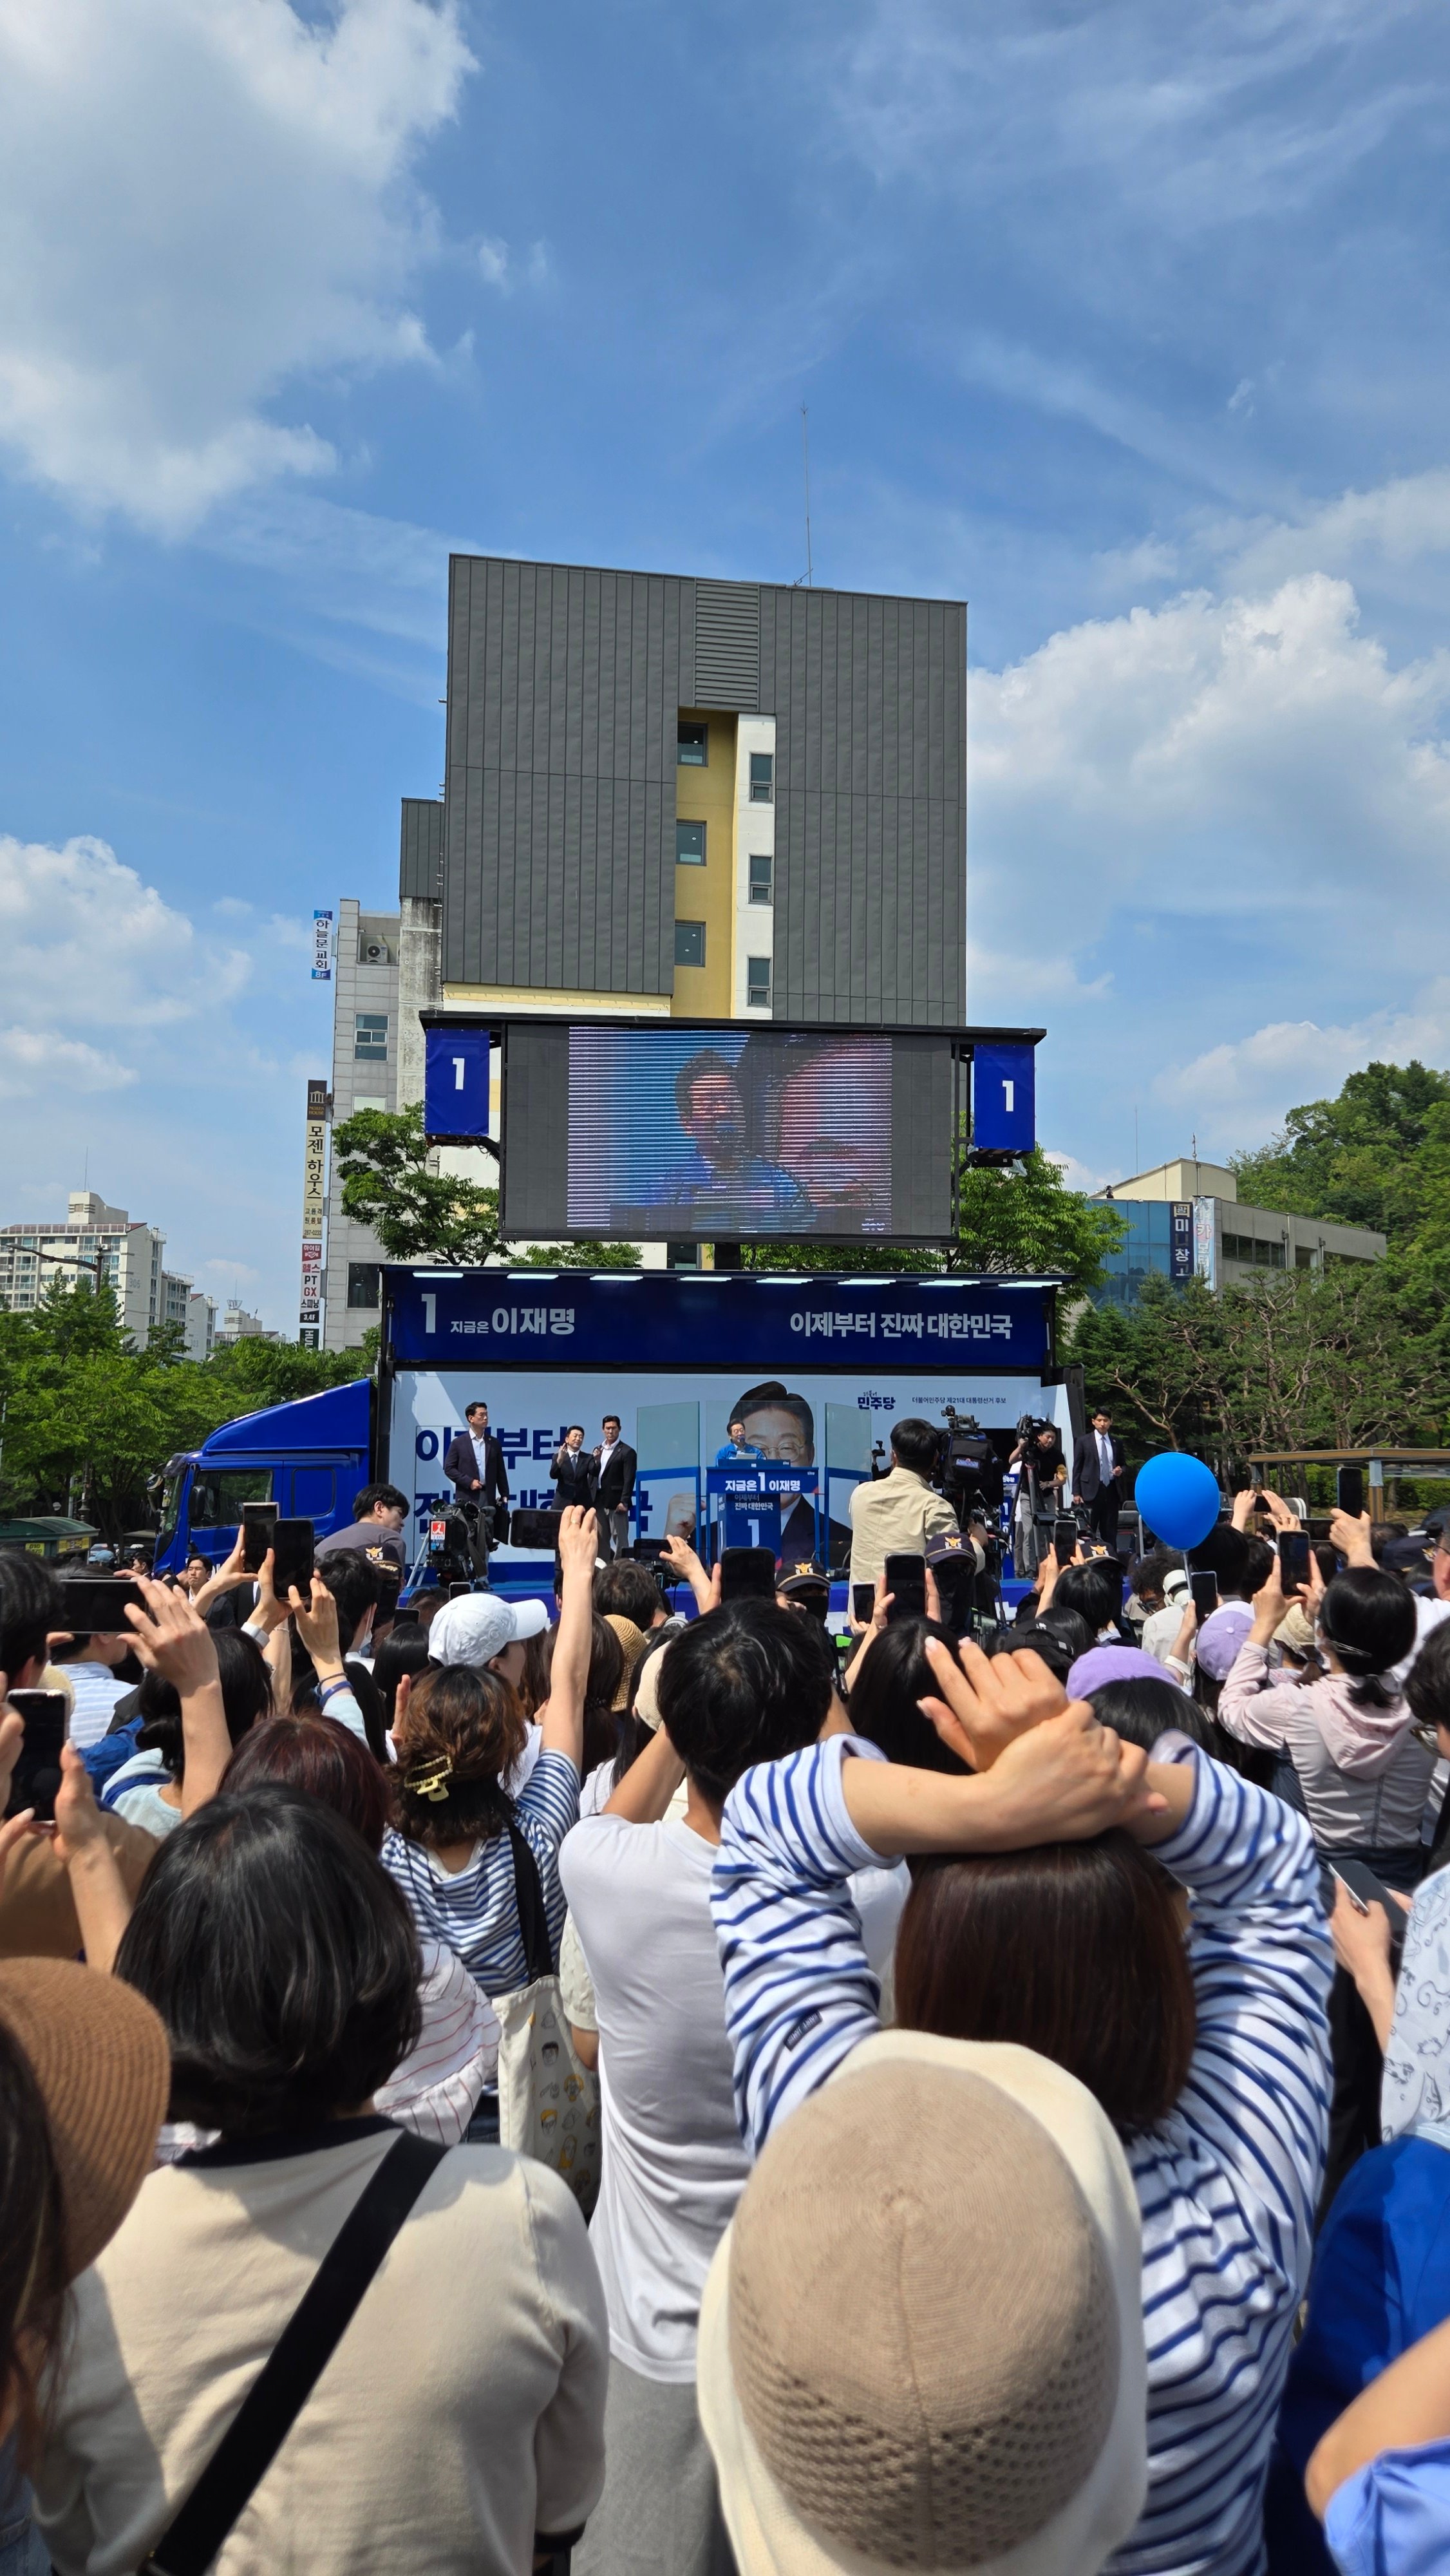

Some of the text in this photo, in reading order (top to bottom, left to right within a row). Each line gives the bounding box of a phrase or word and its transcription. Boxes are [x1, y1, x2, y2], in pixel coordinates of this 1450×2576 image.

[315, 920, 330, 969] 하늘문교회
[453, 1057, 465, 1090] 1
[1003, 1080, 1014, 1112] 1
[306, 1126, 324, 1198] 모젠 하우스
[1175, 1219, 1191, 1276] 미니창고
[303, 1264, 320, 1273] 헬스
[305, 1276, 317, 1285] PT
[301, 1299, 319, 1309] 스피닝
[304, 1287, 317, 1297] GX
[421, 1293, 575, 1335] 1 지금은 이재명
[790, 1312, 1013, 1339] 이제부터 진짜 대한민국
[858, 1397, 896, 1410] 민주당
[416, 1426, 568, 1470] 이부터
[725, 1472, 800, 1492] 지금은 1 이재명
[735, 1502, 748, 1510] 진짜
[748, 1502, 773, 1510] 대한민국
[1003, 1502, 1008, 1515] 1
[748, 1519, 760, 1548] 1
